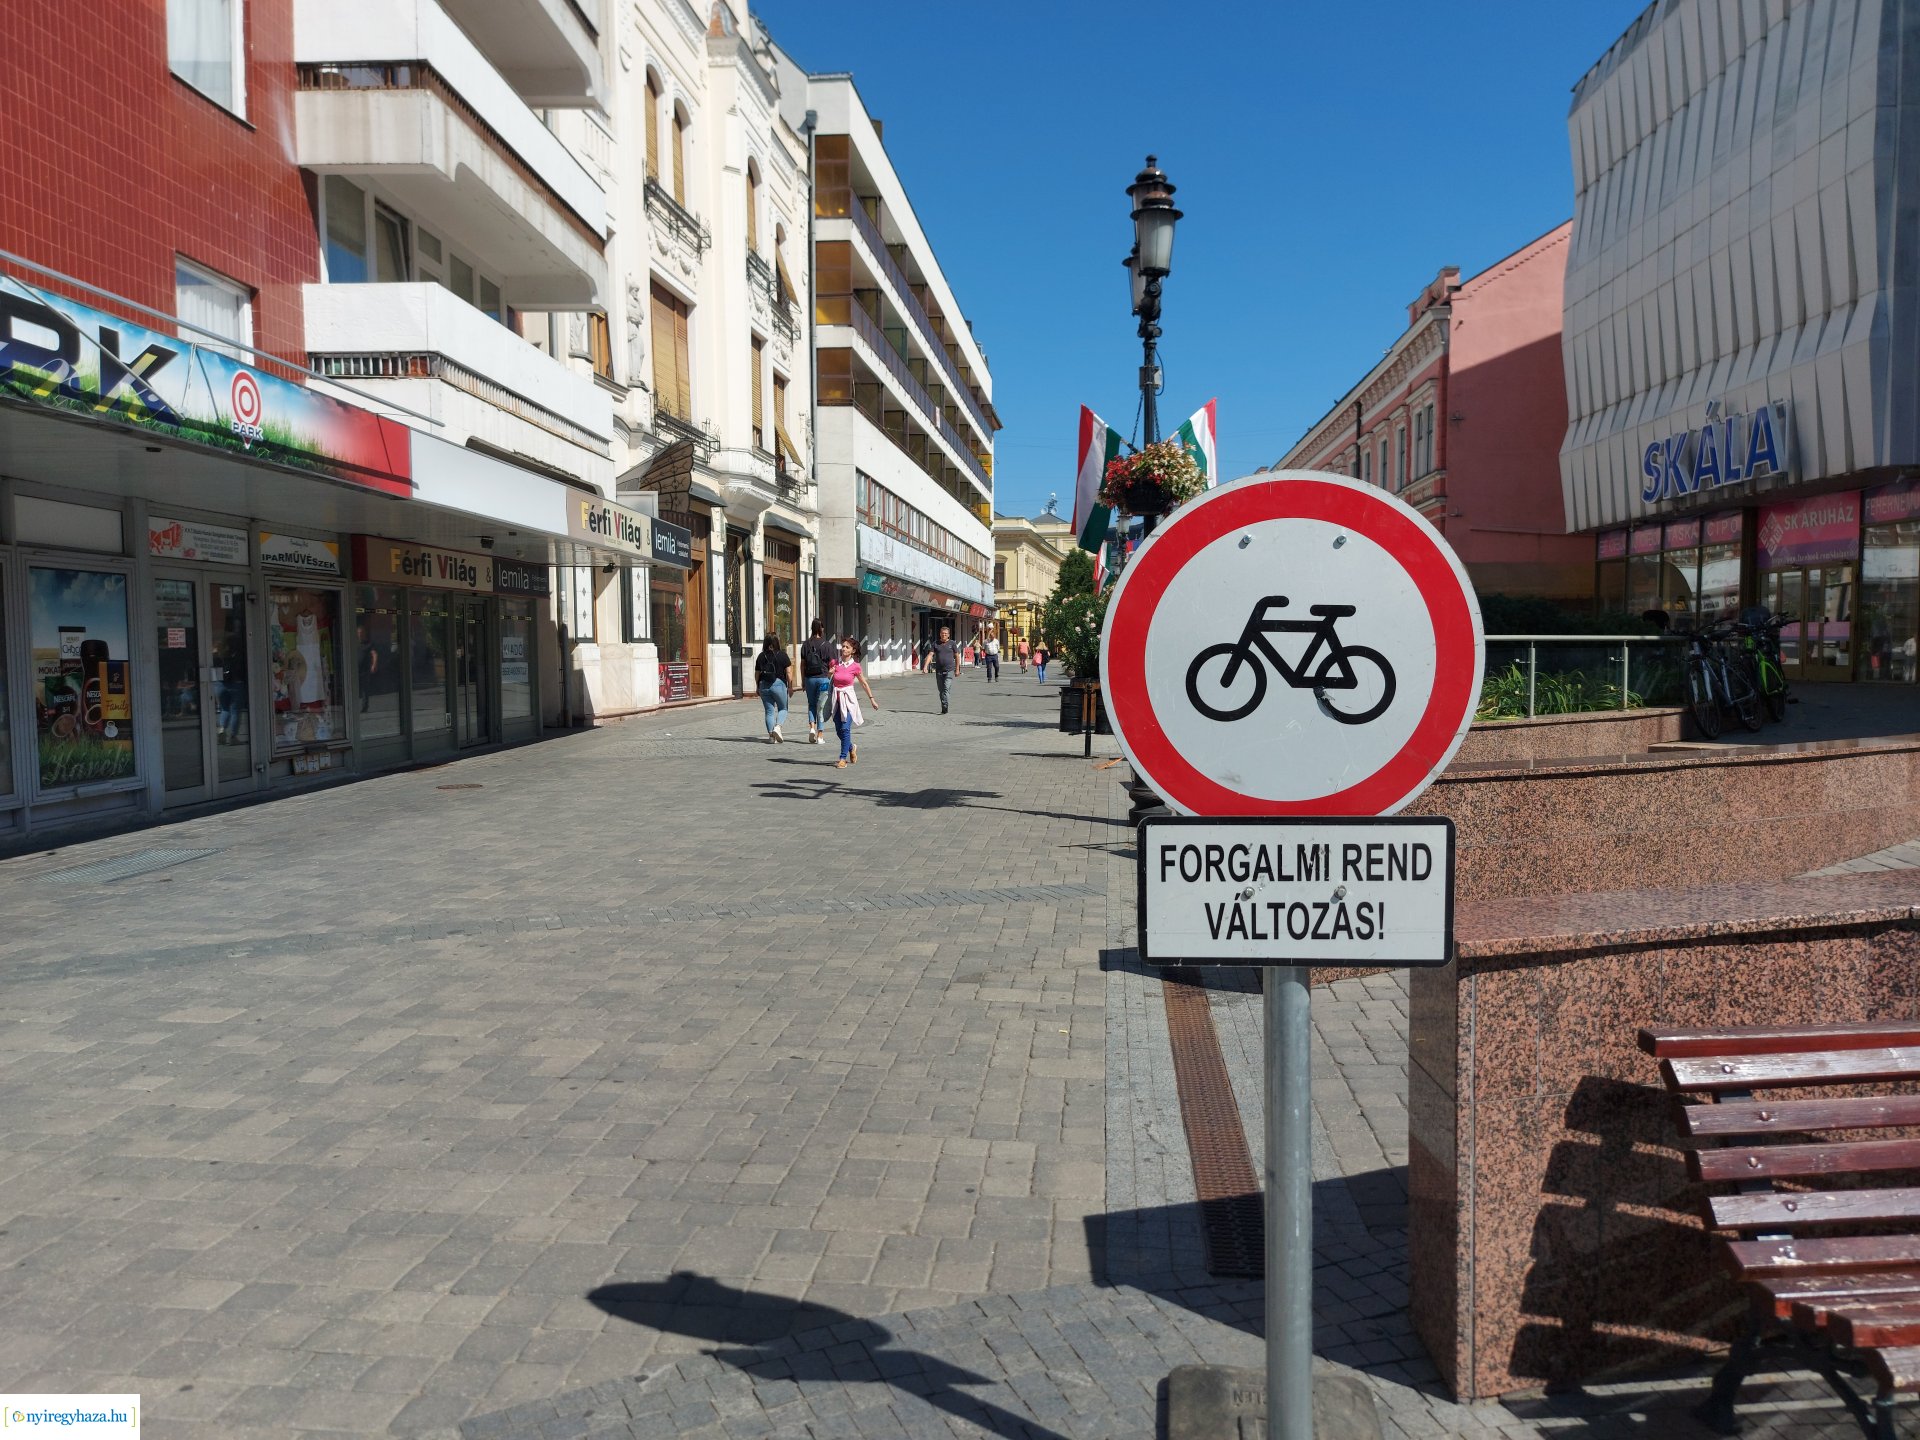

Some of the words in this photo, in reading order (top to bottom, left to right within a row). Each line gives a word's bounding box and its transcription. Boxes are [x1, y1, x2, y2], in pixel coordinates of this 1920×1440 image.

[231, 421, 263, 440] PARK
[1641, 400, 1782, 504] SKÁLA
[580, 499, 612, 536] Férfi
[613, 511, 641, 550] Világ
[655, 527, 677, 554] lemila
[1784, 514, 1798, 531] SK
[262, 551, 337, 569] IPARMŰVÉSZEK
[389, 547, 432, 577] Férfi
[436, 554, 477, 587] Világ
[497, 563, 530, 590] lemila
[1160, 843, 1330, 882] FORGALMI
[1342, 842, 1432, 881] REND
[1204, 892, 1385, 940] VÁLTOZÁS!
